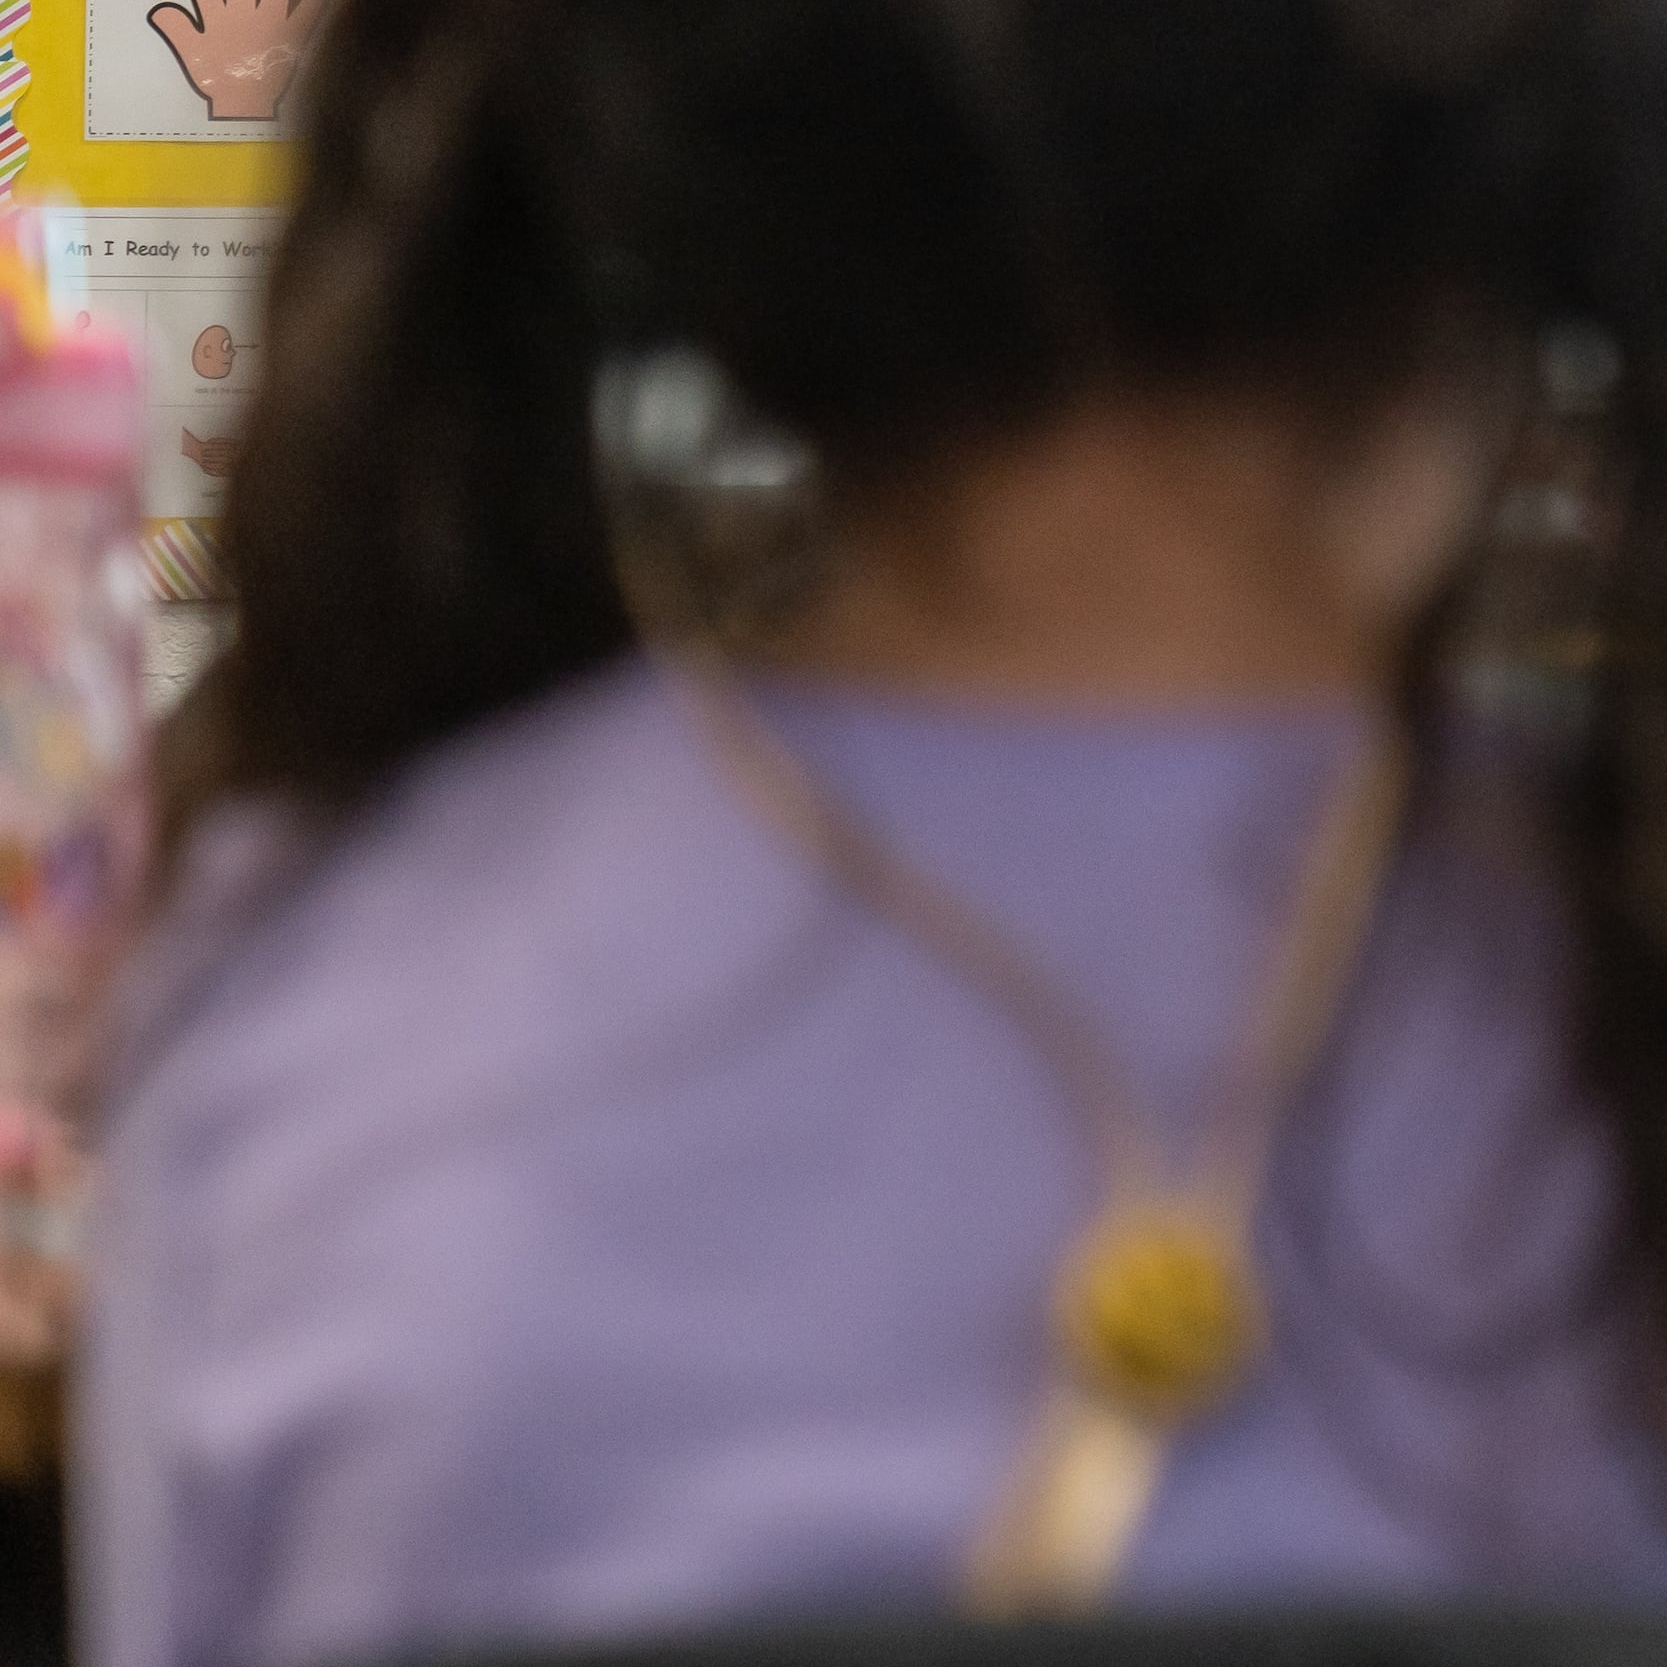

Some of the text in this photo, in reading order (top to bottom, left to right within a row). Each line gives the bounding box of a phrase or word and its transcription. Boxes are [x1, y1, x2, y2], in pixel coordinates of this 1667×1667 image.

[65, 240, 92, 257] Am
[104, 241, 114, 255] I
[127, 241, 180, 261] Ready
[192, 242, 209, 256] to
